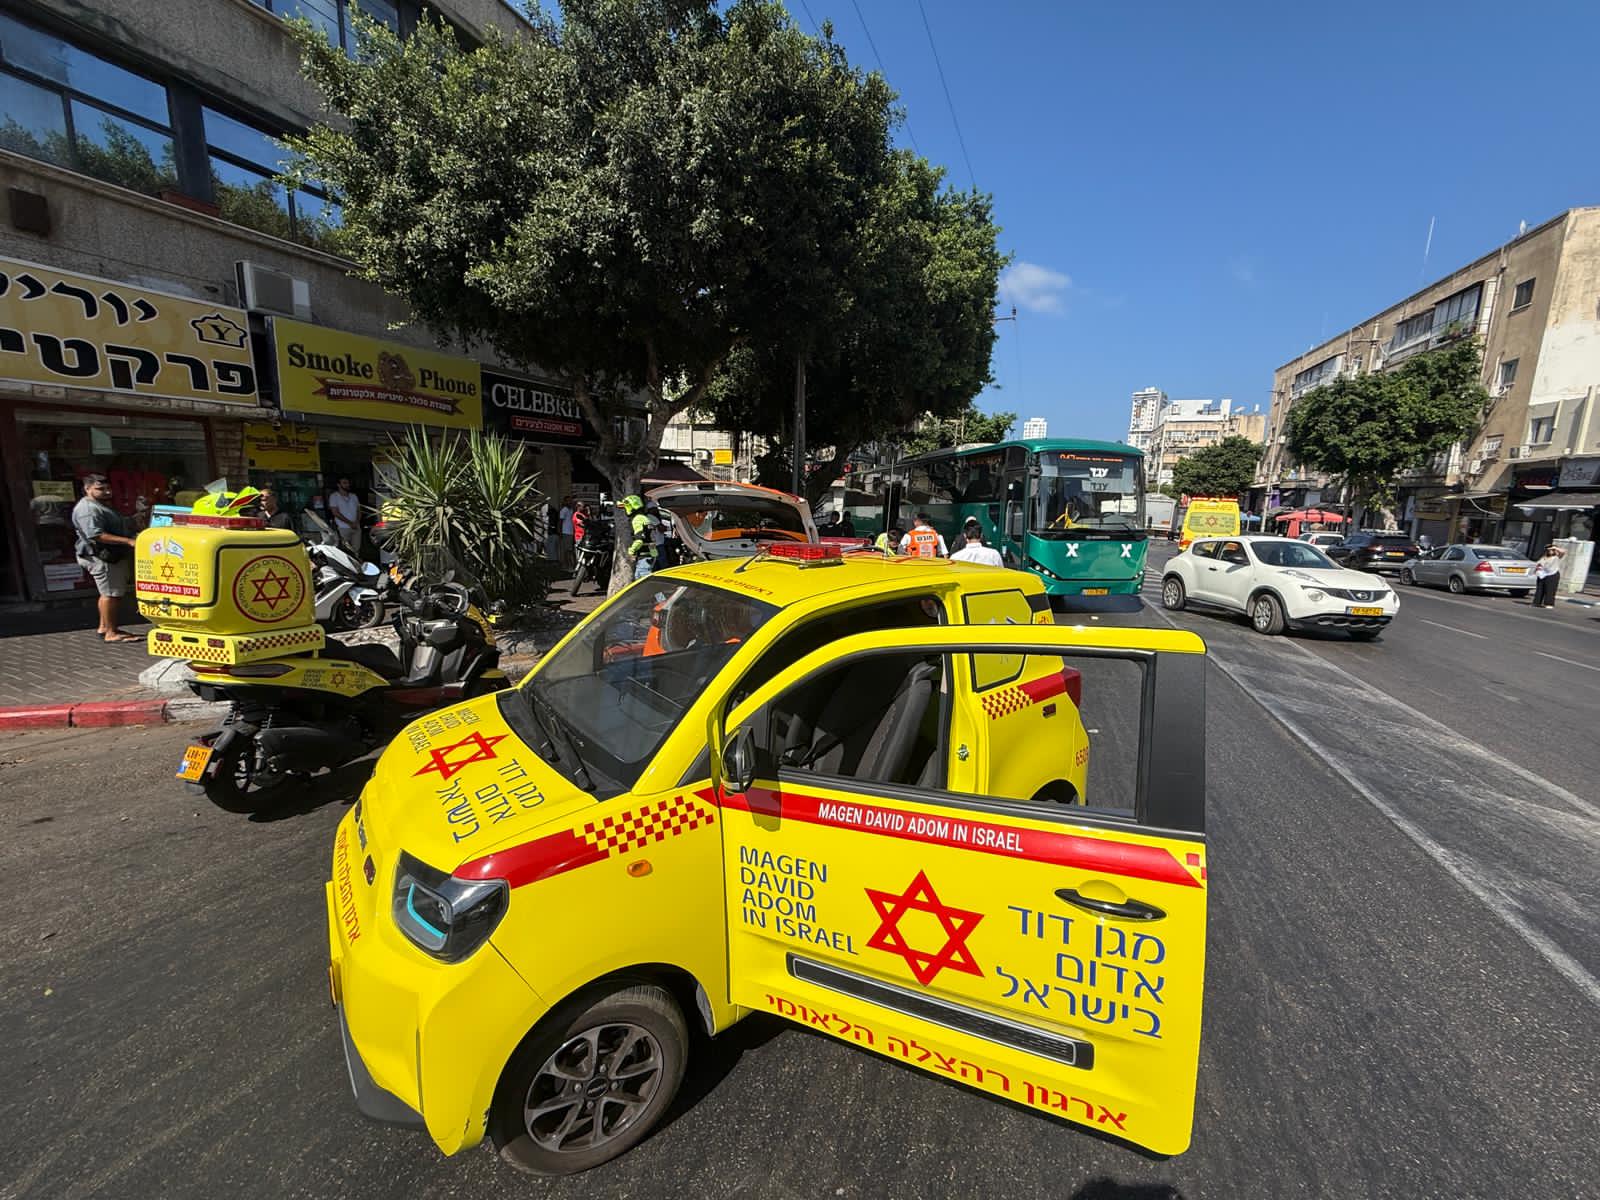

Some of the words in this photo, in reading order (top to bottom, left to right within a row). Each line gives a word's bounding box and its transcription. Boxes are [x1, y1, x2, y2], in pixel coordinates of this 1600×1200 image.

[211, 324, 231, 341] Y
[287, 343, 374, 380] Smoke
[418, 367, 477, 397] Phone
[141, 604, 161, 616] 5122
[175, 608, 192, 618] 101
[497, 758, 528, 783] דוד
[436, 777, 481, 844] בישראל
[475, 783, 517, 825] אדום
[507, 781, 545, 809] מגן
[818, 803, 863, 825] MAGEN
[865, 809, 904, 831] DAVID
[907, 817, 949, 839] ADOM
[952, 824, 968, 842] IN
[972, 827, 1024, 852] ISRAEL
[740, 845, 827, 883] MAGEN
[740, 866, 814, 901] DAVID
[742, 888, 816, 923] ADOM
[1007, 905, 1074, 945] דוד
[743, 906, 766, 929] IN
[775, 916, 859, 956] ISRAEL
[1095, 924, 1166, 965] מגן
[1056, 952, 1165, 1004] אדום
[766, 993, 875, 1046] הלאומי
[996, 966, 1162, 1039] בישראל
[1023, 1080, 1128, 1131] ארגון
